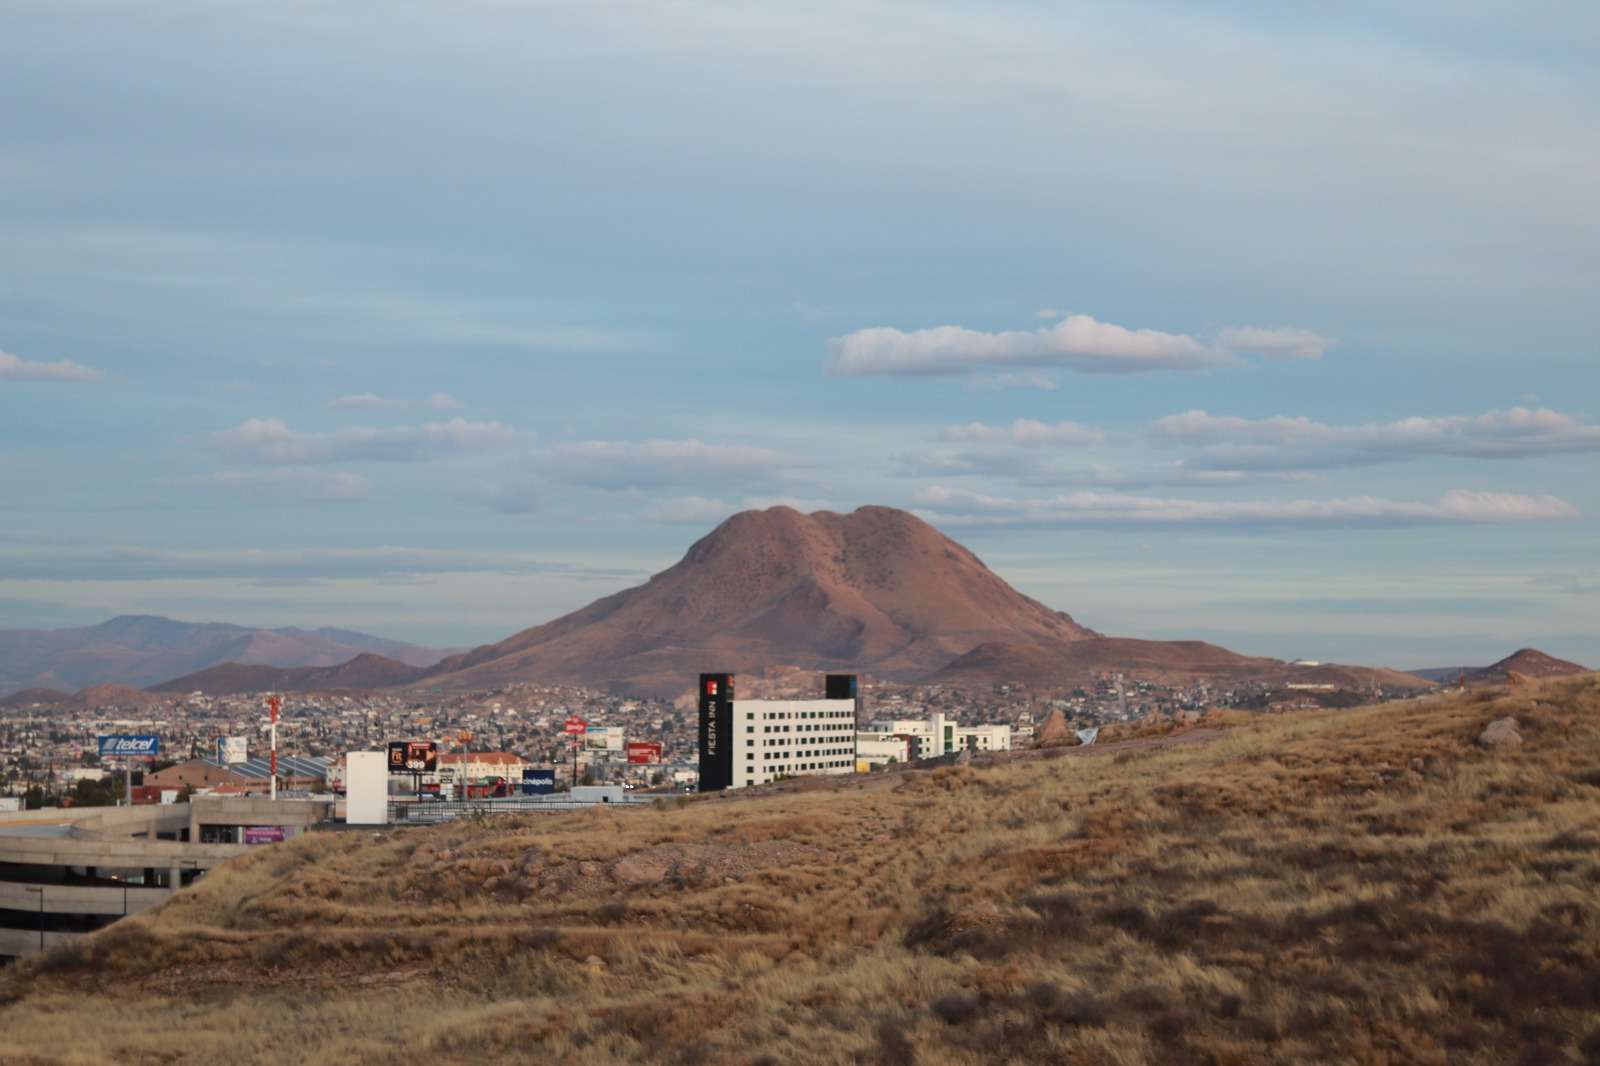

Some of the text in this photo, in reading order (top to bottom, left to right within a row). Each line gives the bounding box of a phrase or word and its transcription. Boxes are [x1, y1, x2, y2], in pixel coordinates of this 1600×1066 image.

[116, 738, 154, 750] telcel
[708, 701, 716, 755] FIESTA INN
